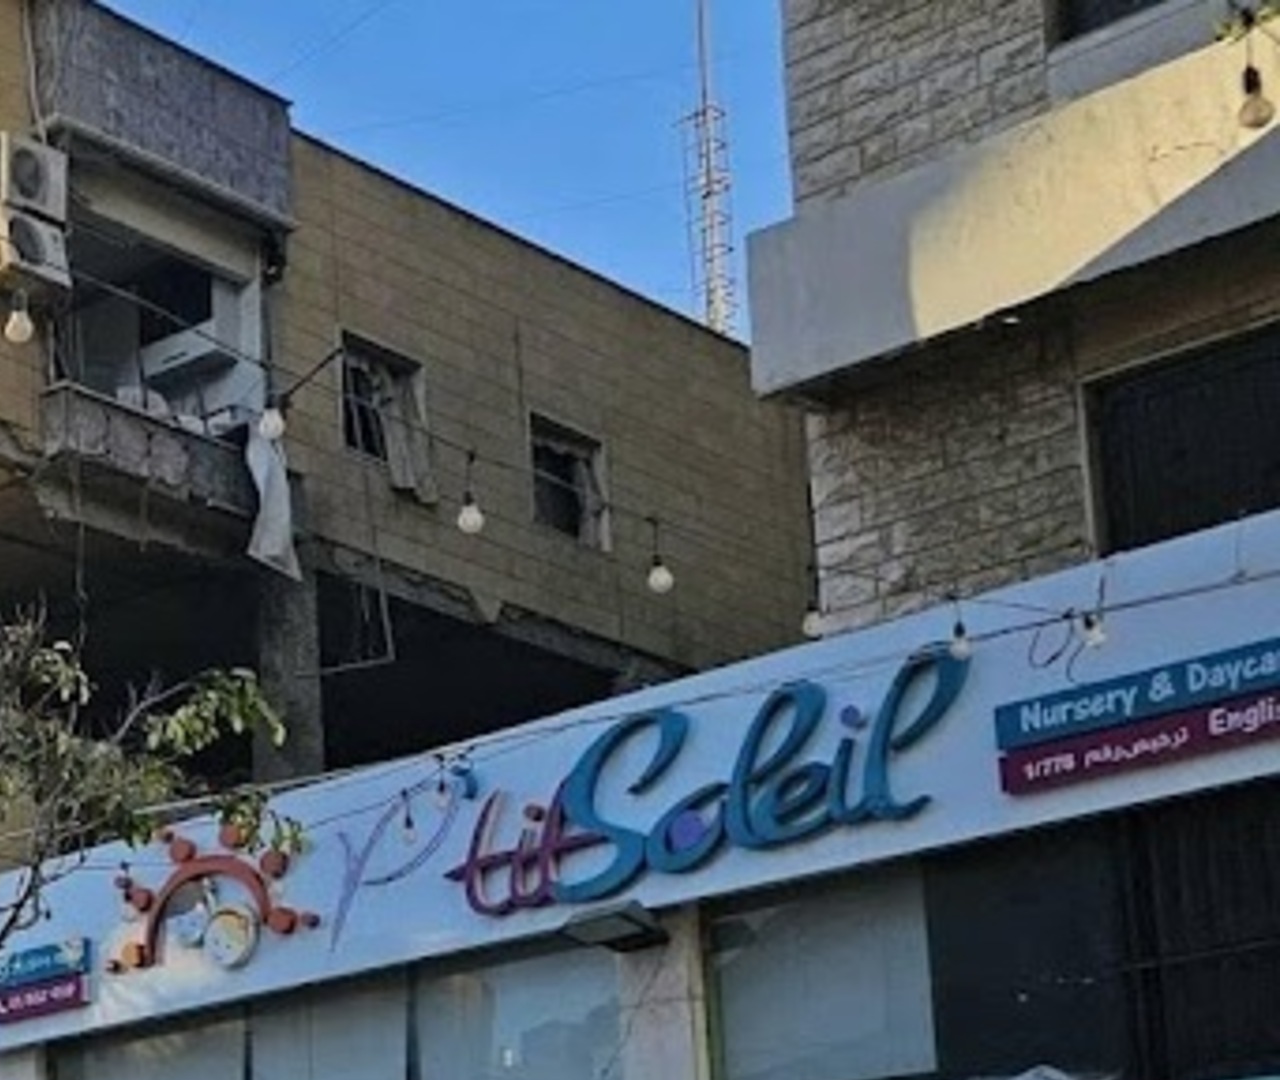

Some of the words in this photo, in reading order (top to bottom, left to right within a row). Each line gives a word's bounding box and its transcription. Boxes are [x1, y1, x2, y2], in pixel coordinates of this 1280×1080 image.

[546, 640, 972, 903] Soleil
[1020, 685, 1138, 732] Nursery
[1148, 670, 1176, 702] &
[1187, 650, 1280, 693] Dayca
